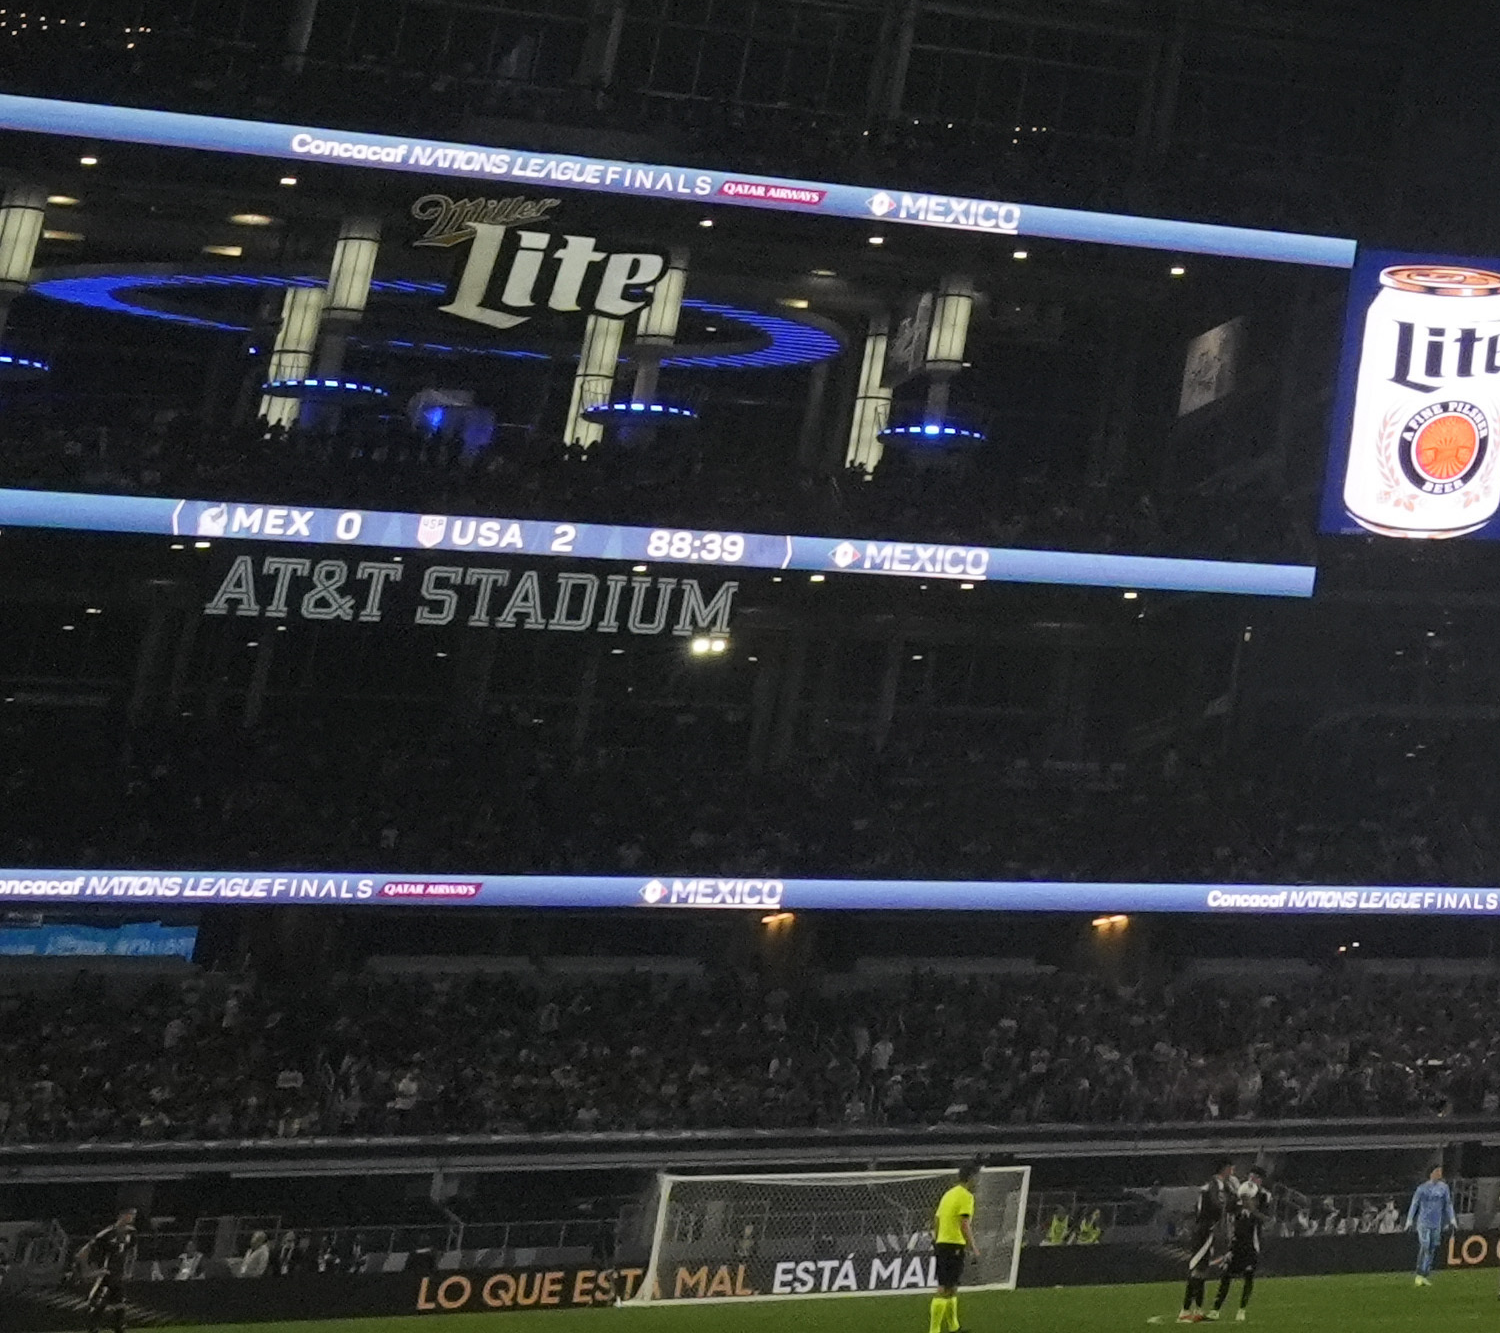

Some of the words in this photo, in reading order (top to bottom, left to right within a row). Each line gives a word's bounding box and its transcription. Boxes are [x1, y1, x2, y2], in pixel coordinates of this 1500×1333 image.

[291, 133, 408, 163] Concacaf
[408, 146, 510, 174] NATIONS
[511, 155, 604, 184] LEAGUE
[605, 166, 712, 196] FINALS
[722, 183, 766, 197] QATAR
[767, 188, 820, 203] AIRWAYS
[412, 194, 561, 245] Miller
[899, 193, 1021, 229] MEXICO
[438, 222, 664, 329] Lite
[1409, 403, 1444, 431] FINE
[1422, 479, 1464, 495] BEER
[231, 508, 311, 536] MEX
[336, 512, 363, 541] 0
[451, 519, 524, 549] USA
[551, 524, 577, 552] 2
[646, 529, 745, 562] 88:39
[863, 542, 989, 575] MEXICO
[204, 555, 404, 623] AT&T
[415, 566, 739, 638] STADIUM
[416, 1275, 472, 1310] LO
[481, 1271, 565, 1309] QUE
[772, 1253, 858, 1294] ESTÁ
